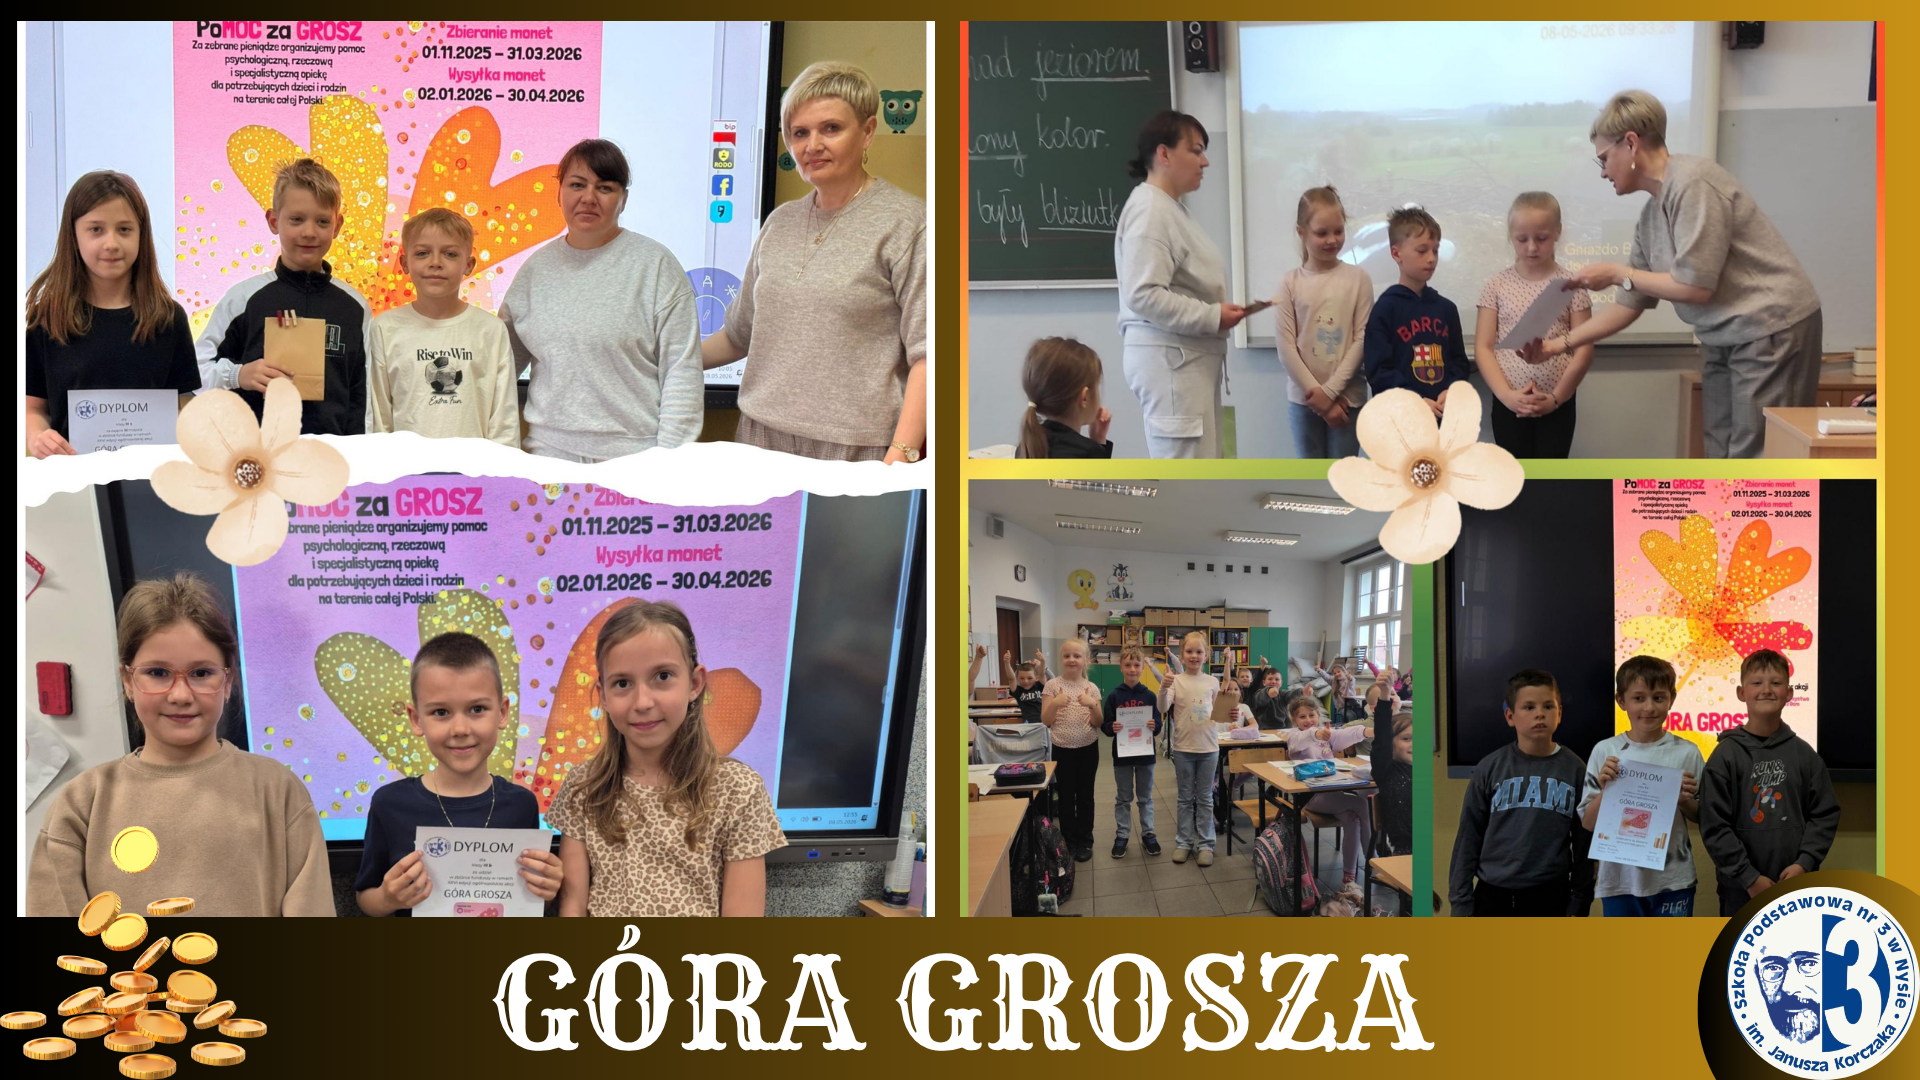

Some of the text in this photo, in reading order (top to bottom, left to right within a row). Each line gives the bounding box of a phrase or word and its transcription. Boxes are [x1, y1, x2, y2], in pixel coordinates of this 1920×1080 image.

[197, 21, 362, 41] PoMOC za GROSZ
[446, 25, 553, 39] Zbieranie monet
[192, 40, 365, 54] Za zebrane pieniądze organizujemy pomoc
[422, 46, 492, 59] 01.11.2025
[507, 47, 582, 60] 31.03.2026
[292, 58, 332, 68] rzeczową
[231, 68, 327, 80] i specjalistyczną opiekę
[448, 67, 545, 83] Wysyłka monet
[211, 81, 346, 93] dla potrzebujących dzieci i rodzin
[233, 95, 243, 103] na
[245, 95, 275, 104] terenie
[277, 95, 297, 106] całej
[418, 88, 492, 101] 02.01.2026
[508, 89, 584, 102] 30.04.2026
[416, 348, 439, 361] Rise
[450, 347, 473, 361] Win
[99, 402, 148, 414] DYPLOM
[1673, 479, 1705, 489] GROSZ
[356, 496, 389, 516] za
[395, 487, 483, 517] GROSZ
[322, 521, 374, 535] pieniądze
[376, 521, 449, 535] organizujemy
[452, 522, 488, 535] pomoc
[562, 516, 653, 535] 01.11.2025
[673, 512, 772, 533] 31.03.2026
[303, 539, 445, 554] psychologiczną, rzeczową
[596, 544, 722, 568] Wysyłka monet
[312, 556, 439, 572] i specjalistyczną opiekę
[288, 573, 464, 590] dla potrzebujących dzieci i rodzin
[556, 573, 652, 592] 02.01.2026
[672, 570, 772, 589] 30.04.2026
[319, 594, 332, 604] na
[334, 593, 373, 604] terenie
[375, 592, 401, 607] całej
[1629, 769, 1663, 783] DYPLOM
[453, 841, 514, 853] DYPLOM
[444, 888, 512, 899] GÓRA GROSZA
